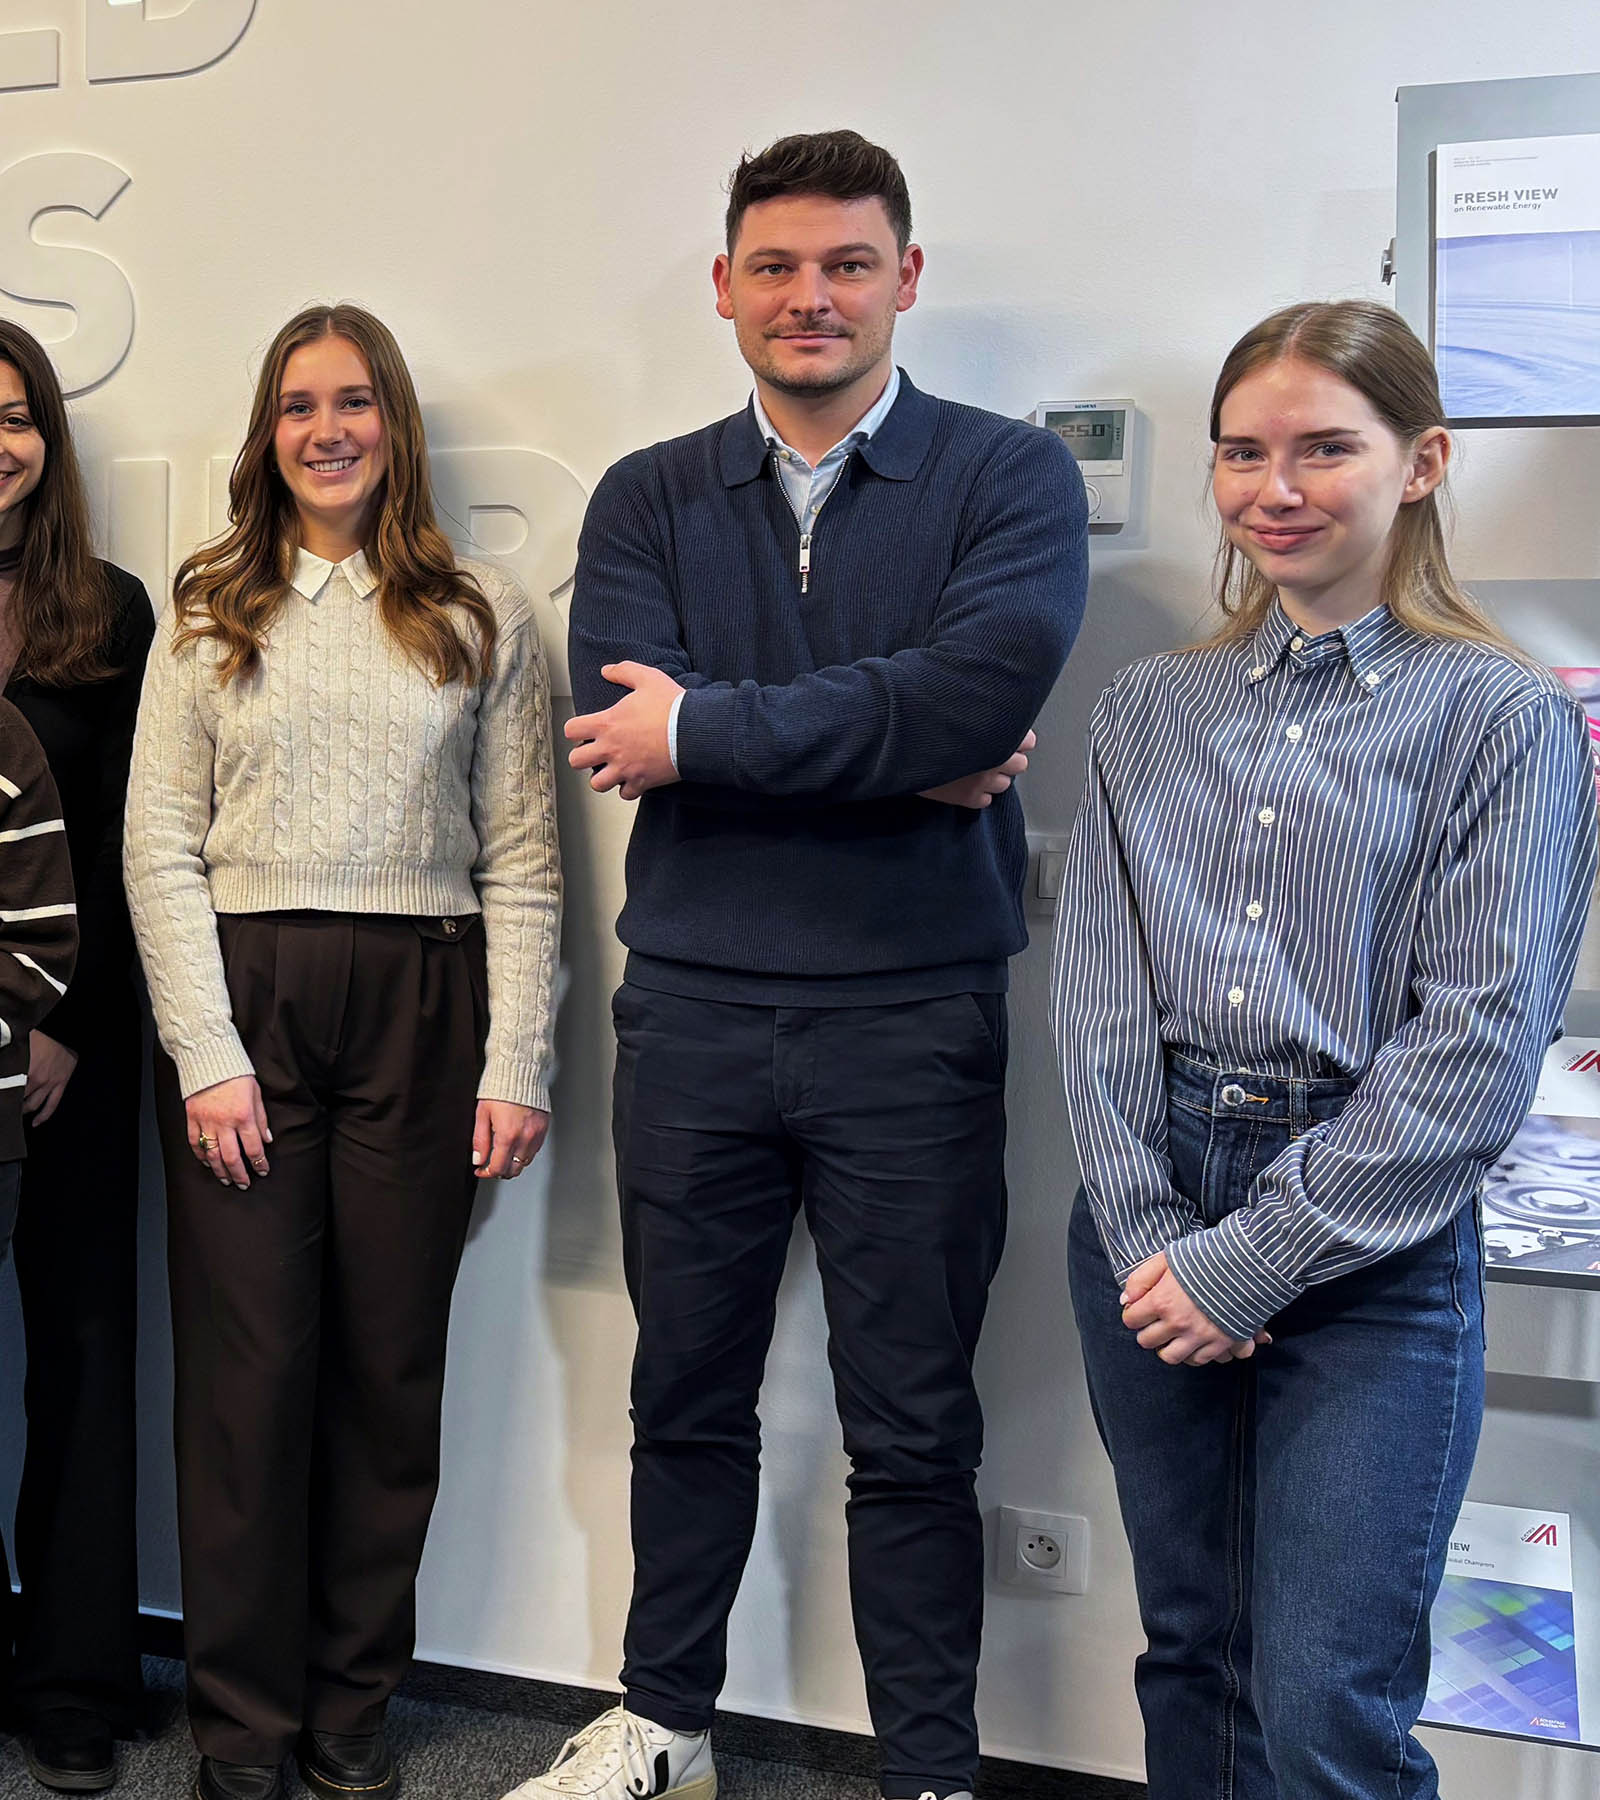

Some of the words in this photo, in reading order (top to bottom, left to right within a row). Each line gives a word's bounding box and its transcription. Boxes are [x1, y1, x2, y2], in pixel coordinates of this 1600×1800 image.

[1454, 191, 1509, 204] FRESH
[1514, 188, 1558, 200] VIEW
[1466, 203, 1511, 212] Renewable
[1513, 202, 1542, 210] Energy
[1450, 1542, 1470, 1552] IEW
